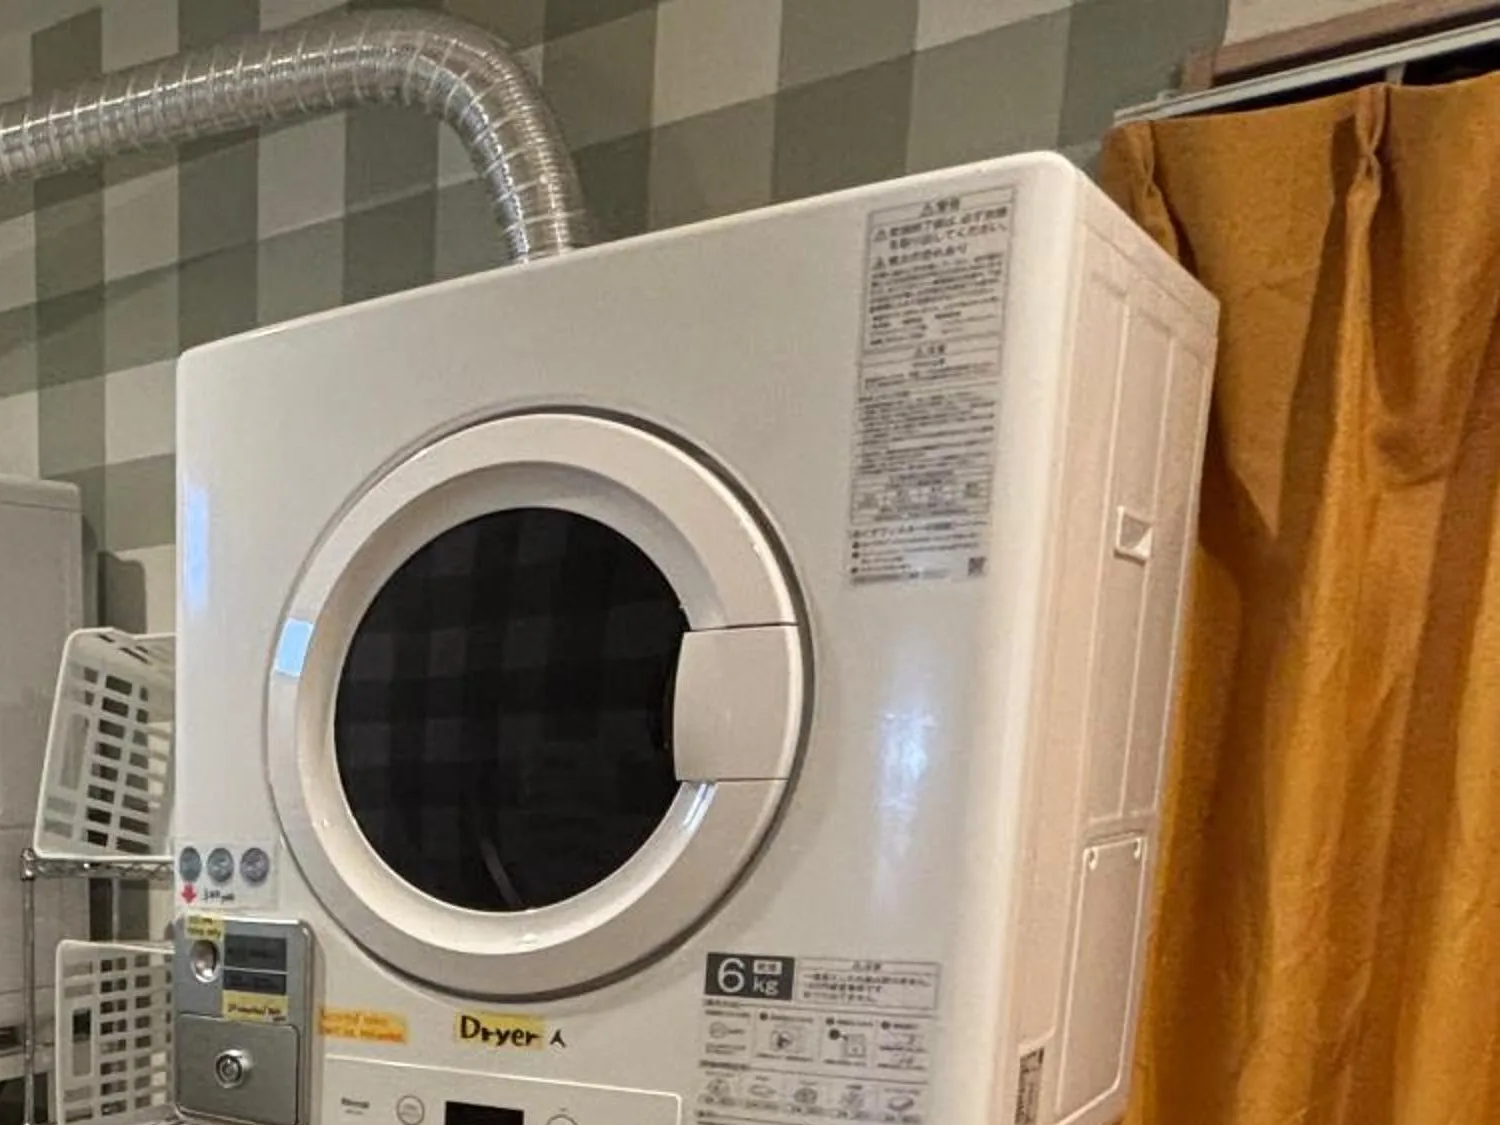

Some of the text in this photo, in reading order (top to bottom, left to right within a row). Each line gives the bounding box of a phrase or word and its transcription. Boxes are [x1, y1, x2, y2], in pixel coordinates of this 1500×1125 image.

[717, 957, 746, 994] 6
[753, 977, 780, 996] kg
[460, 1015, 540, 1048] Dryer
